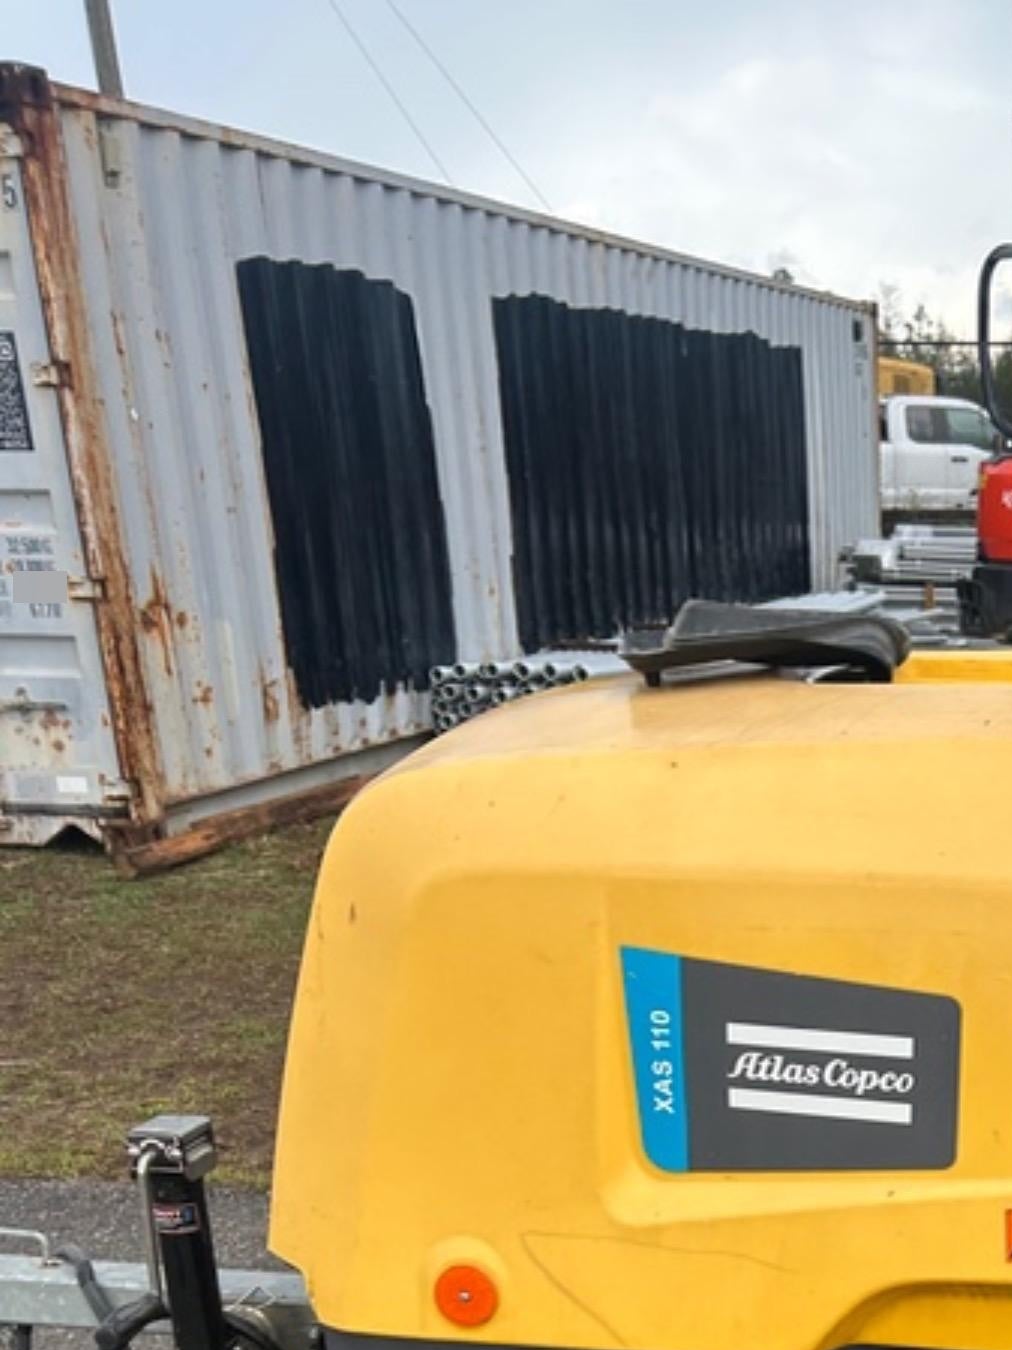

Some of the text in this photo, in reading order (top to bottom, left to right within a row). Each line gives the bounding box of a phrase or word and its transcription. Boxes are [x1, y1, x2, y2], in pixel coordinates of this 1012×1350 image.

[649, 1009, 676, 1115] XAS 110
[726, 1051, 914, 1095] Atlas Copco
